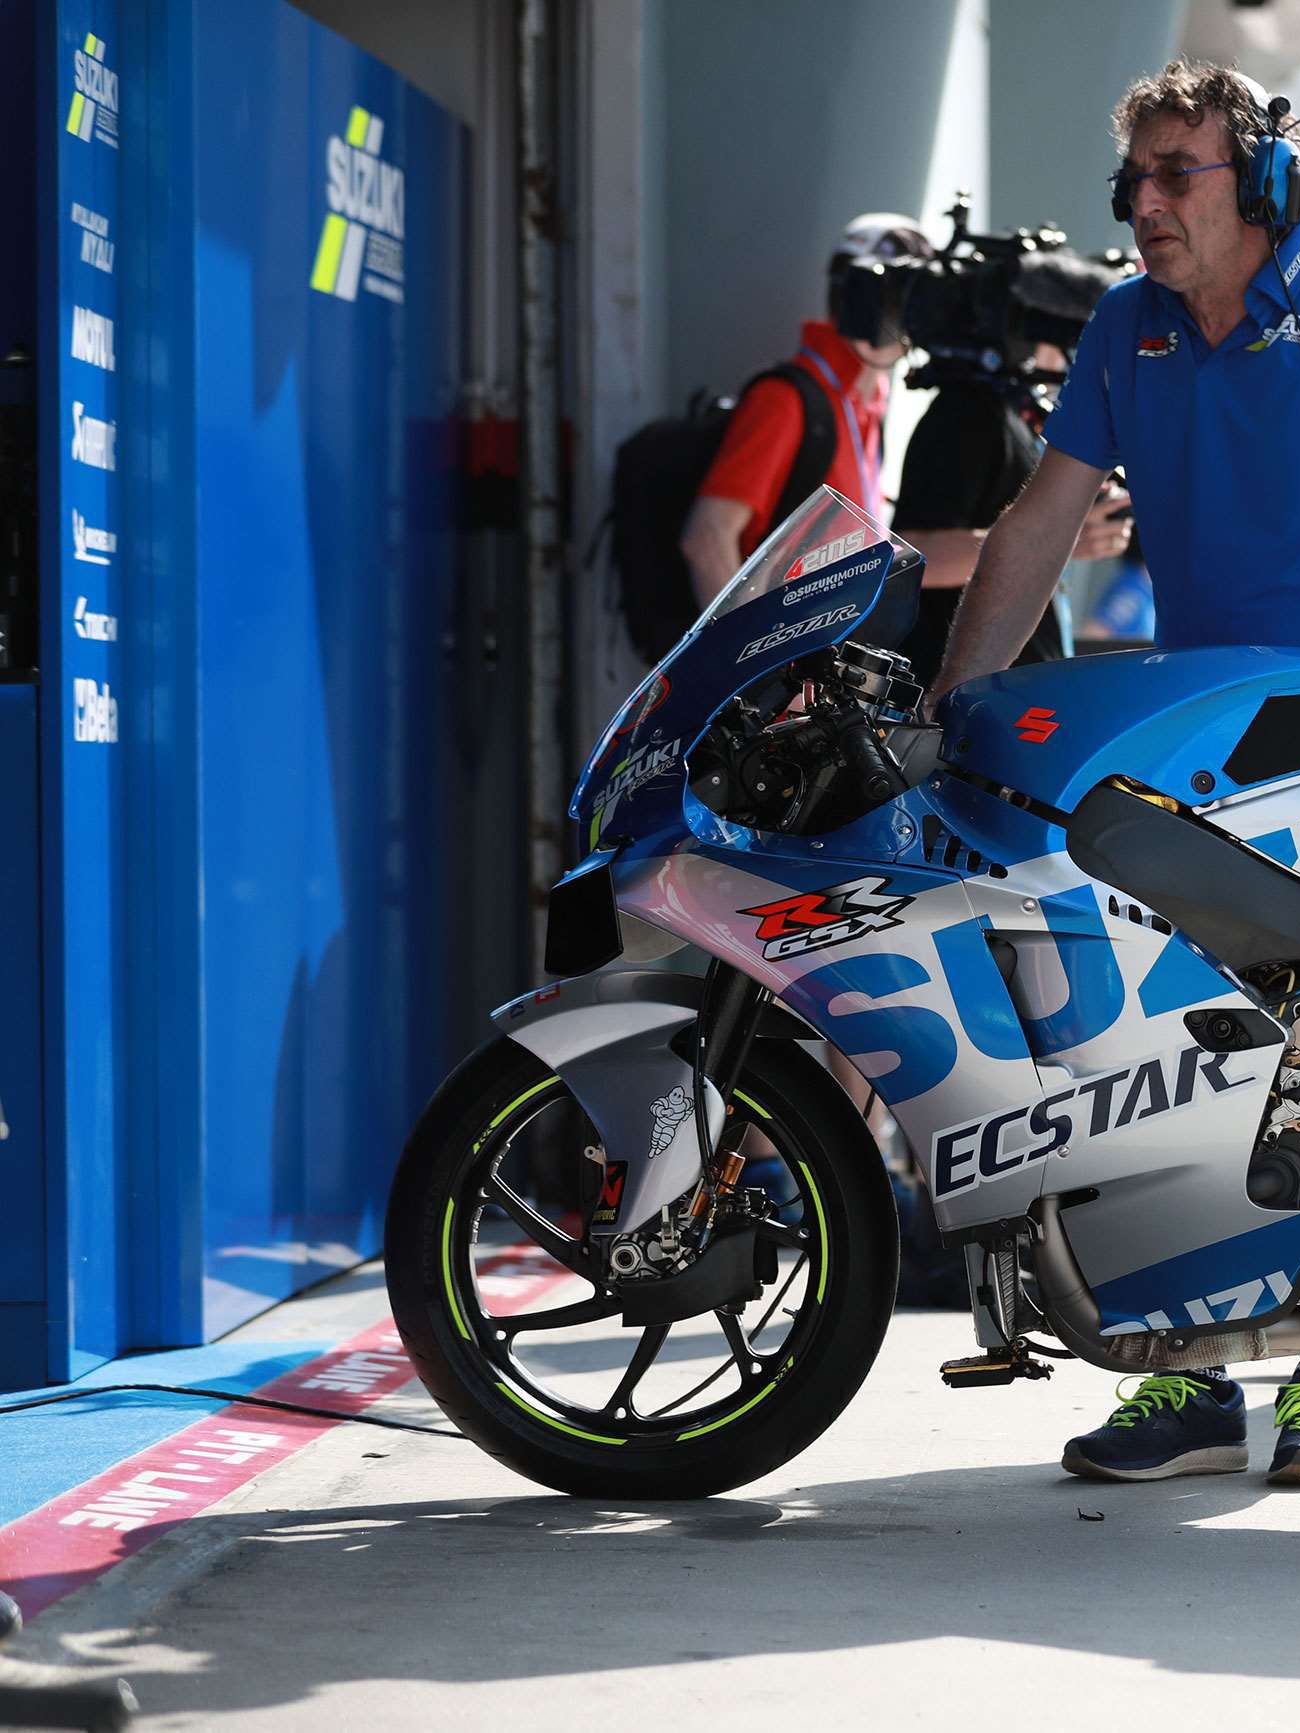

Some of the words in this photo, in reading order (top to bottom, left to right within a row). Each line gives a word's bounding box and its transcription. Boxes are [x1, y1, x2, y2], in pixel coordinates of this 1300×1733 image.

[327, 135, 405, 242] SUZUKI
[783, 558, 882, 606] @SUZUKIMOTOGP
[736, 603, 860, 664] ECSTAR
[593, 737, 681, 815] SUZUKI
[763, 903, 904, 963] GSX
[934, 1044, 1257, 1200] ECSTAR
